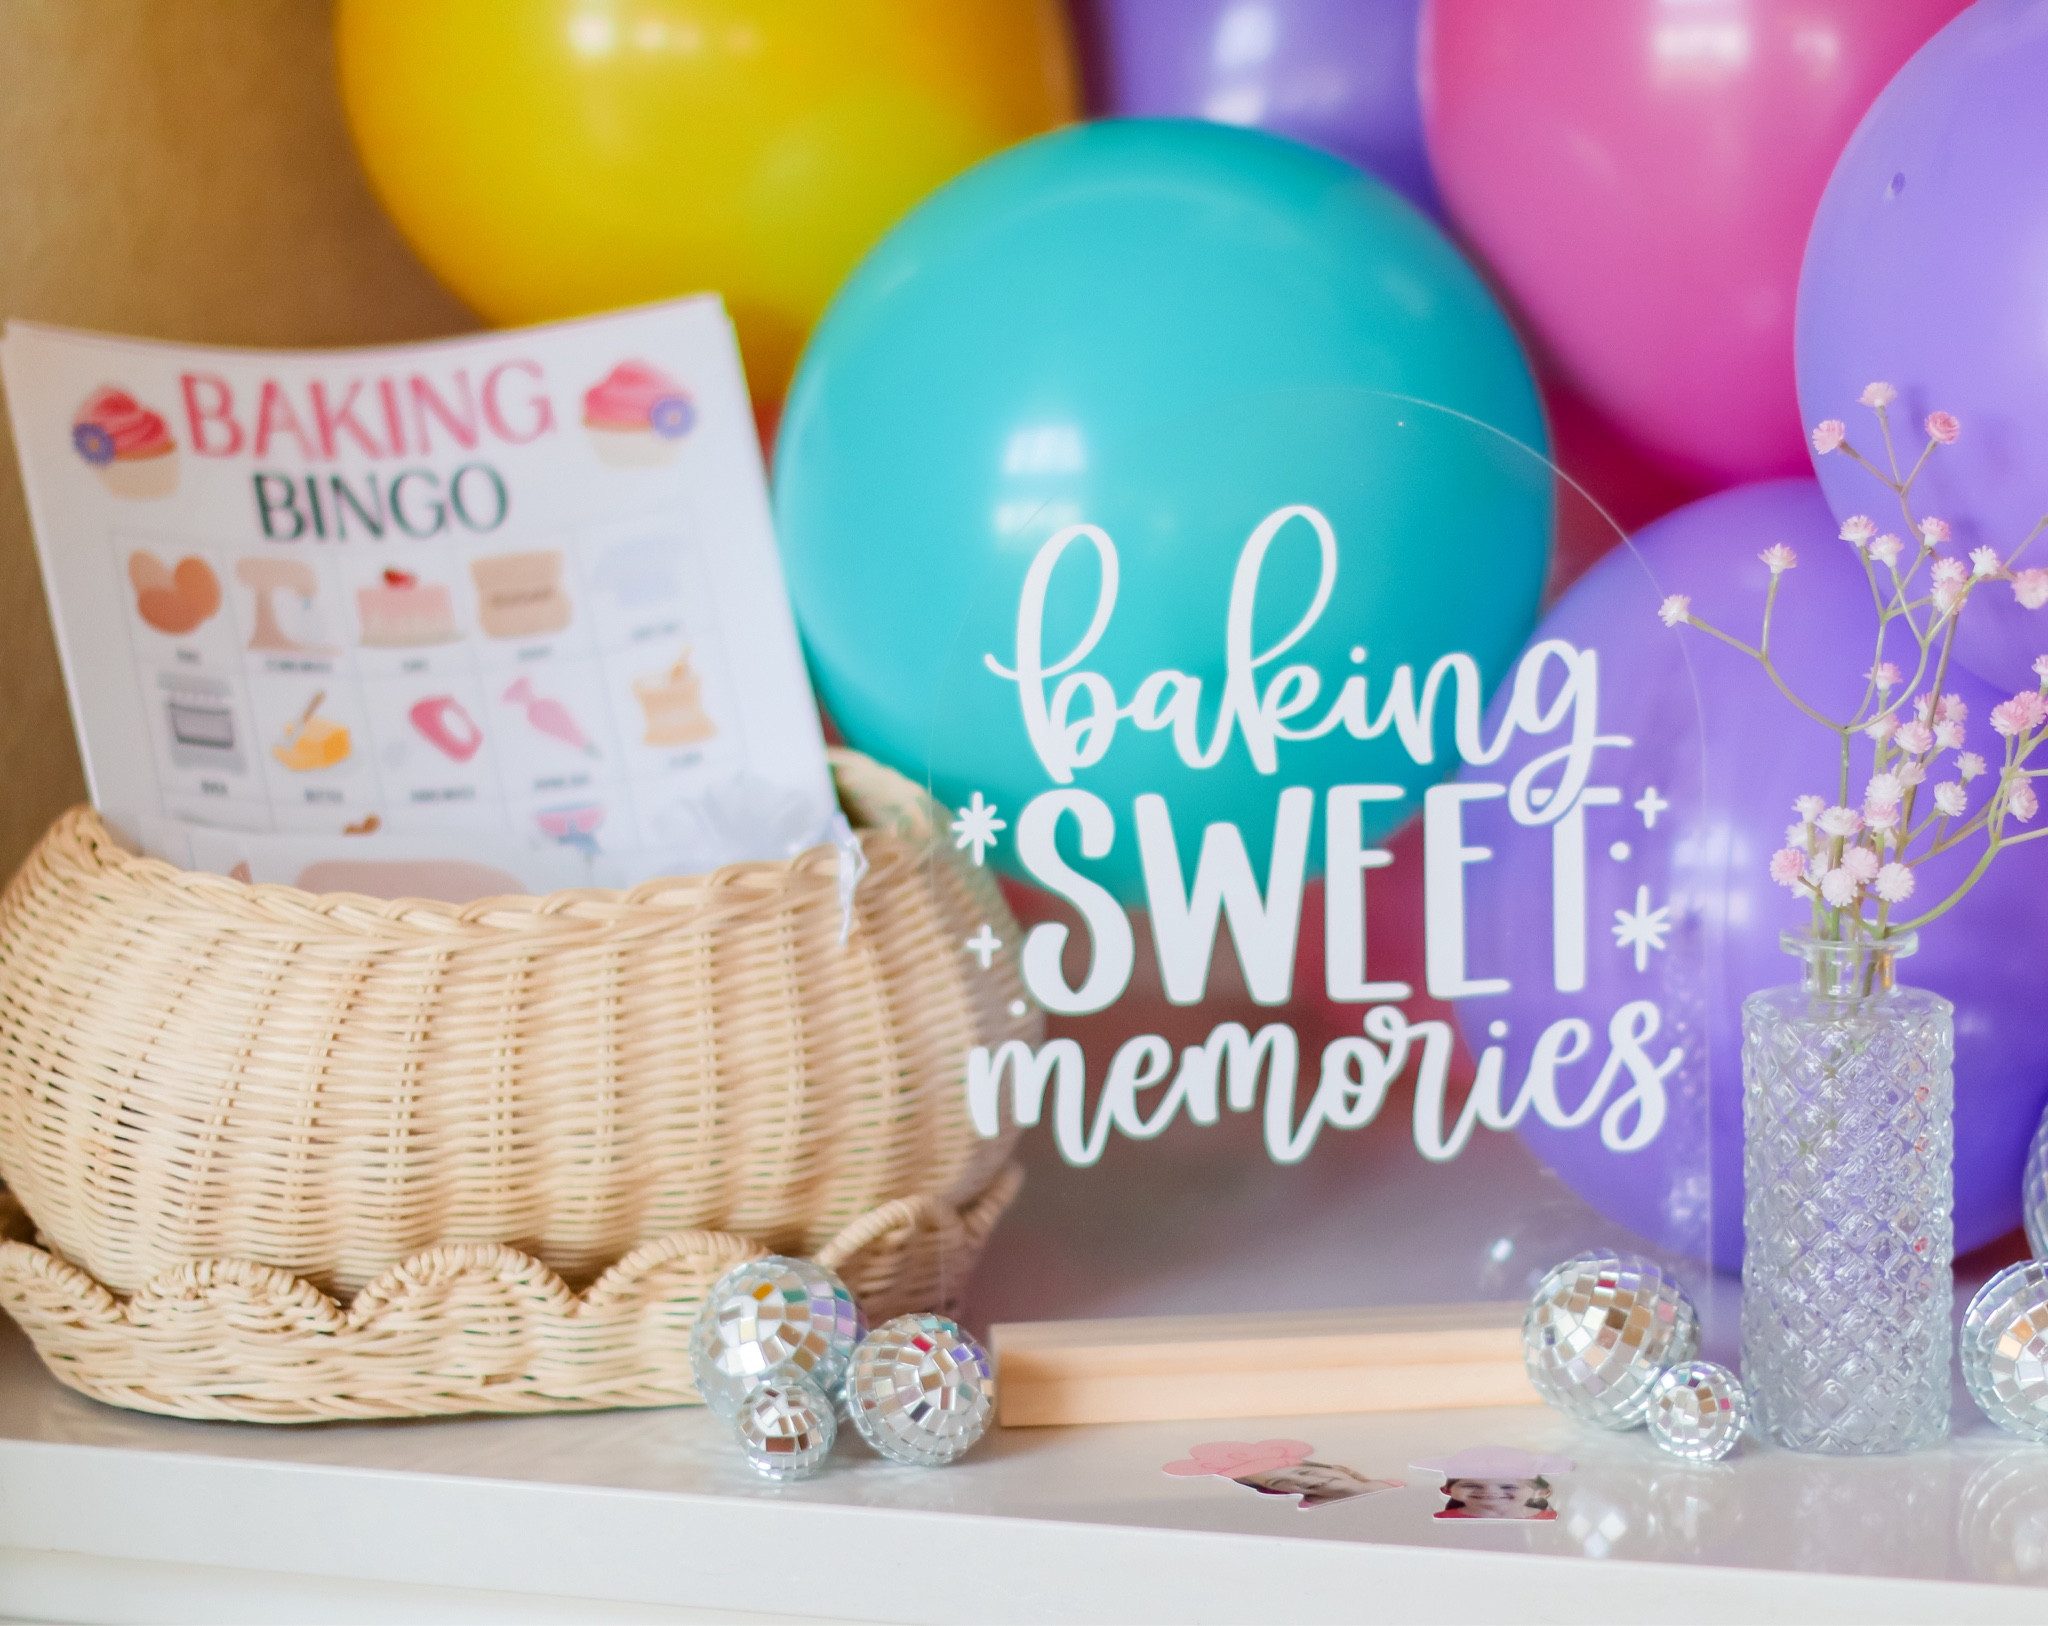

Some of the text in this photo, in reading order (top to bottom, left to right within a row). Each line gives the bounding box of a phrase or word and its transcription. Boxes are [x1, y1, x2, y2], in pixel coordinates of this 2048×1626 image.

[177, 357, 557, 462] BAKING
[251, 462, 511, 543] BINGO
[983, 504, 1633, 826] baking
[1015, 783, 1622, 1015] SWEET
[967, 1001, 1683, 1166] memories
